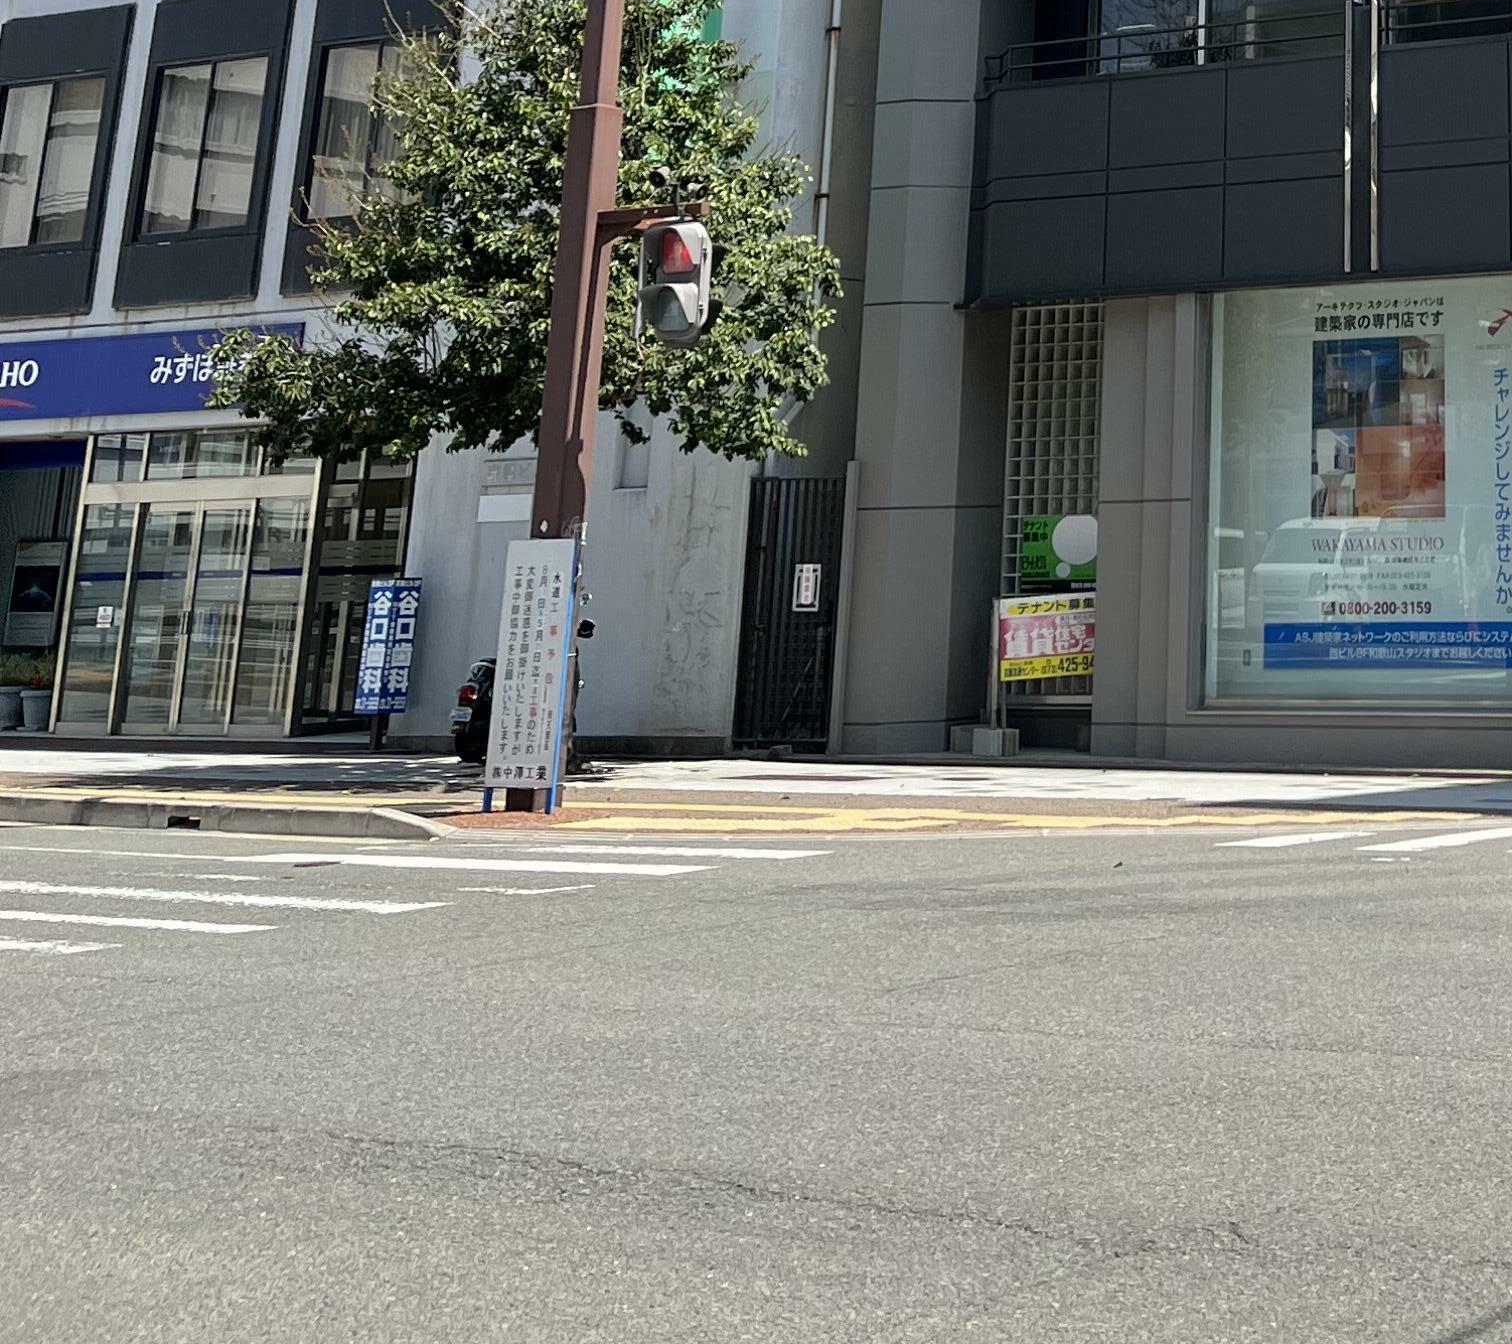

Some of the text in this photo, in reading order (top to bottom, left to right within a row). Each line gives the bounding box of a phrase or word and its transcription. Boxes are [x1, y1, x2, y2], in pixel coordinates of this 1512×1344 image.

[1314, 310, 1444, 332] 建築家の専門店です
[150, 352, 253, 385] みずほ
[1493, 367, 1512, 614] チャレンジしてみませんか。
[1312, 537, 1444, 552] WAKAYAMA STUDIO
[1339, 601, 1432, 615] 0800-200-3159
